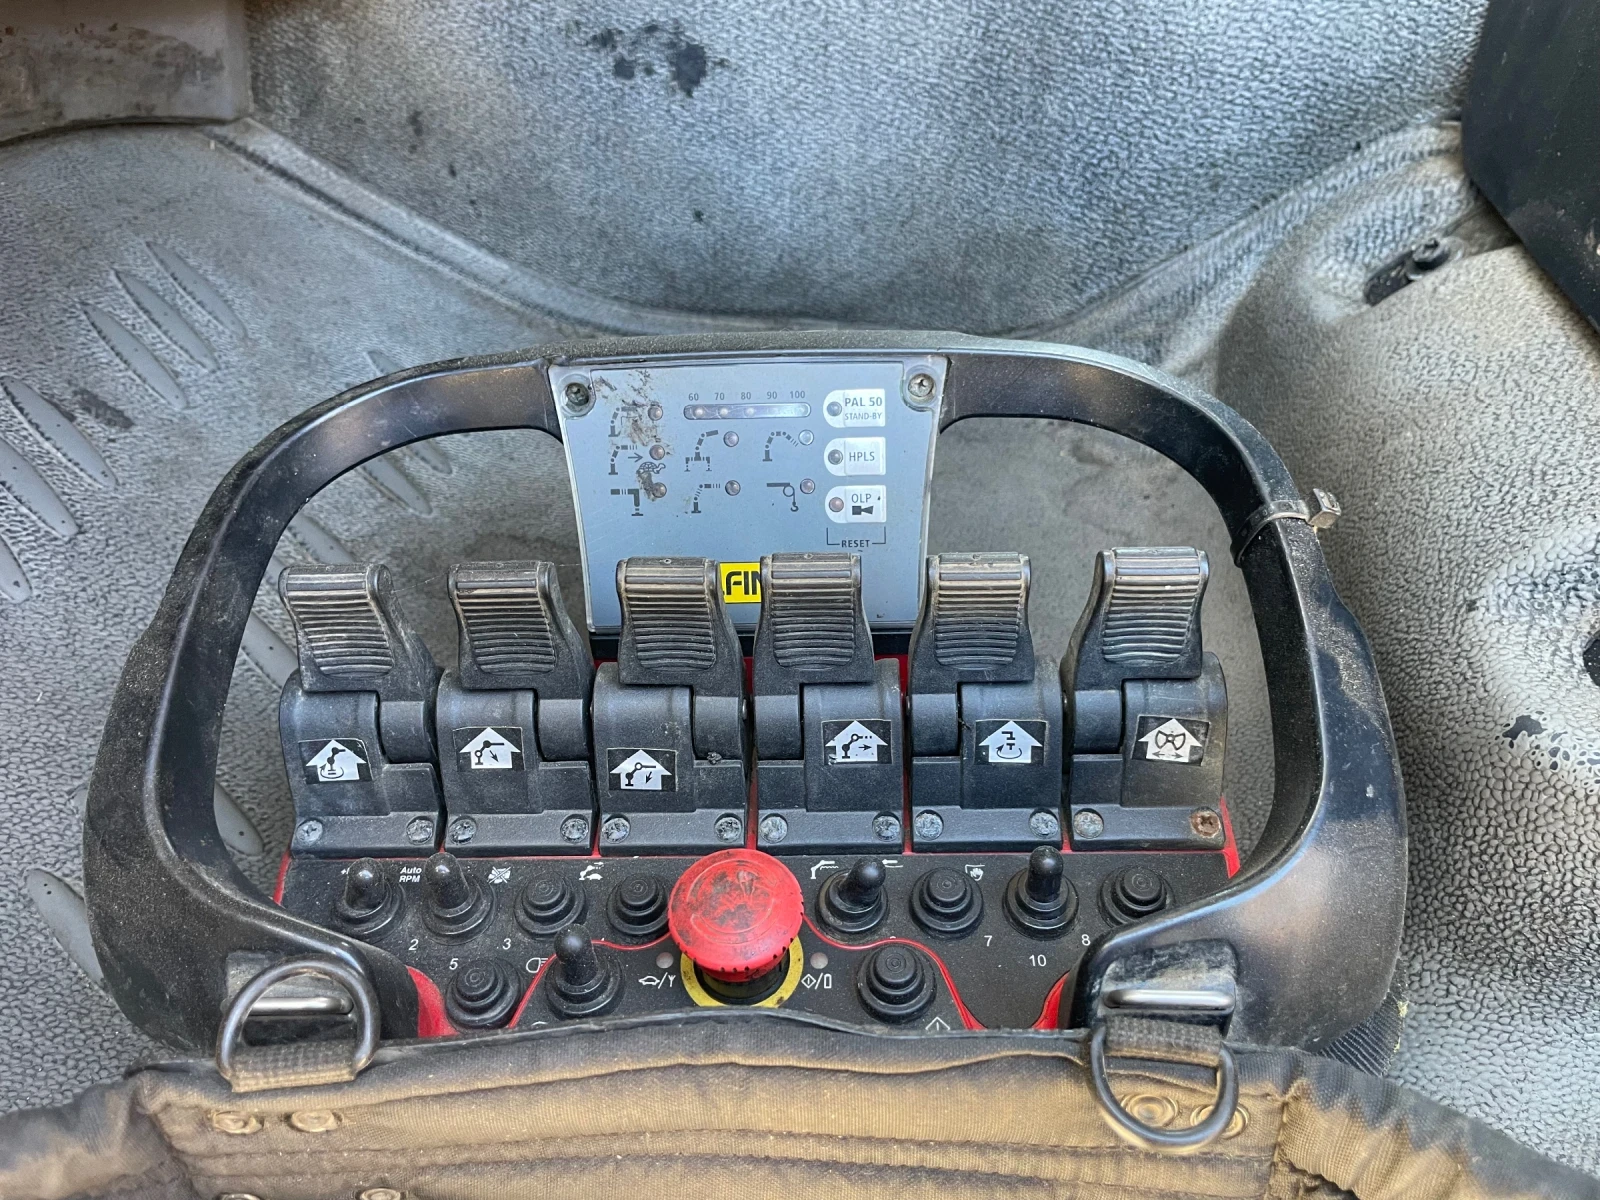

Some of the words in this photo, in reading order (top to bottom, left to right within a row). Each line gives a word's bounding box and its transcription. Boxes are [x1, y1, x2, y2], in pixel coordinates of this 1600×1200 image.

[688, 392, 699, 402] 60
[714, 392, 725, 401] 70
[740, 391, 752, 401] 80
[766, 390, 778, 400] 90
[789, 390, 806, 400] 100
[844, 396, 866, 407] PAL
[868, 396, 883, 407] 50
[844, 411, 883, 421] STAND-BY
[848, 451, 876, 462] HPLS
[851, 492, 872, 504] OLP
[841, 539, 871, 548] RESET
[722, 570, 762, 596] FIN
[399, 865, 423, 875] Auto
[398, 874, 421, 883] RPM
[407, 938, 420, 952] 2
[501, 937, 512, 951] 3
[983, 934, 993, 947] 7
[1080, 933, 1092, 947] 8
[448, 957, 460, 971] 5
[1028, 953, 1047, 968] 10
